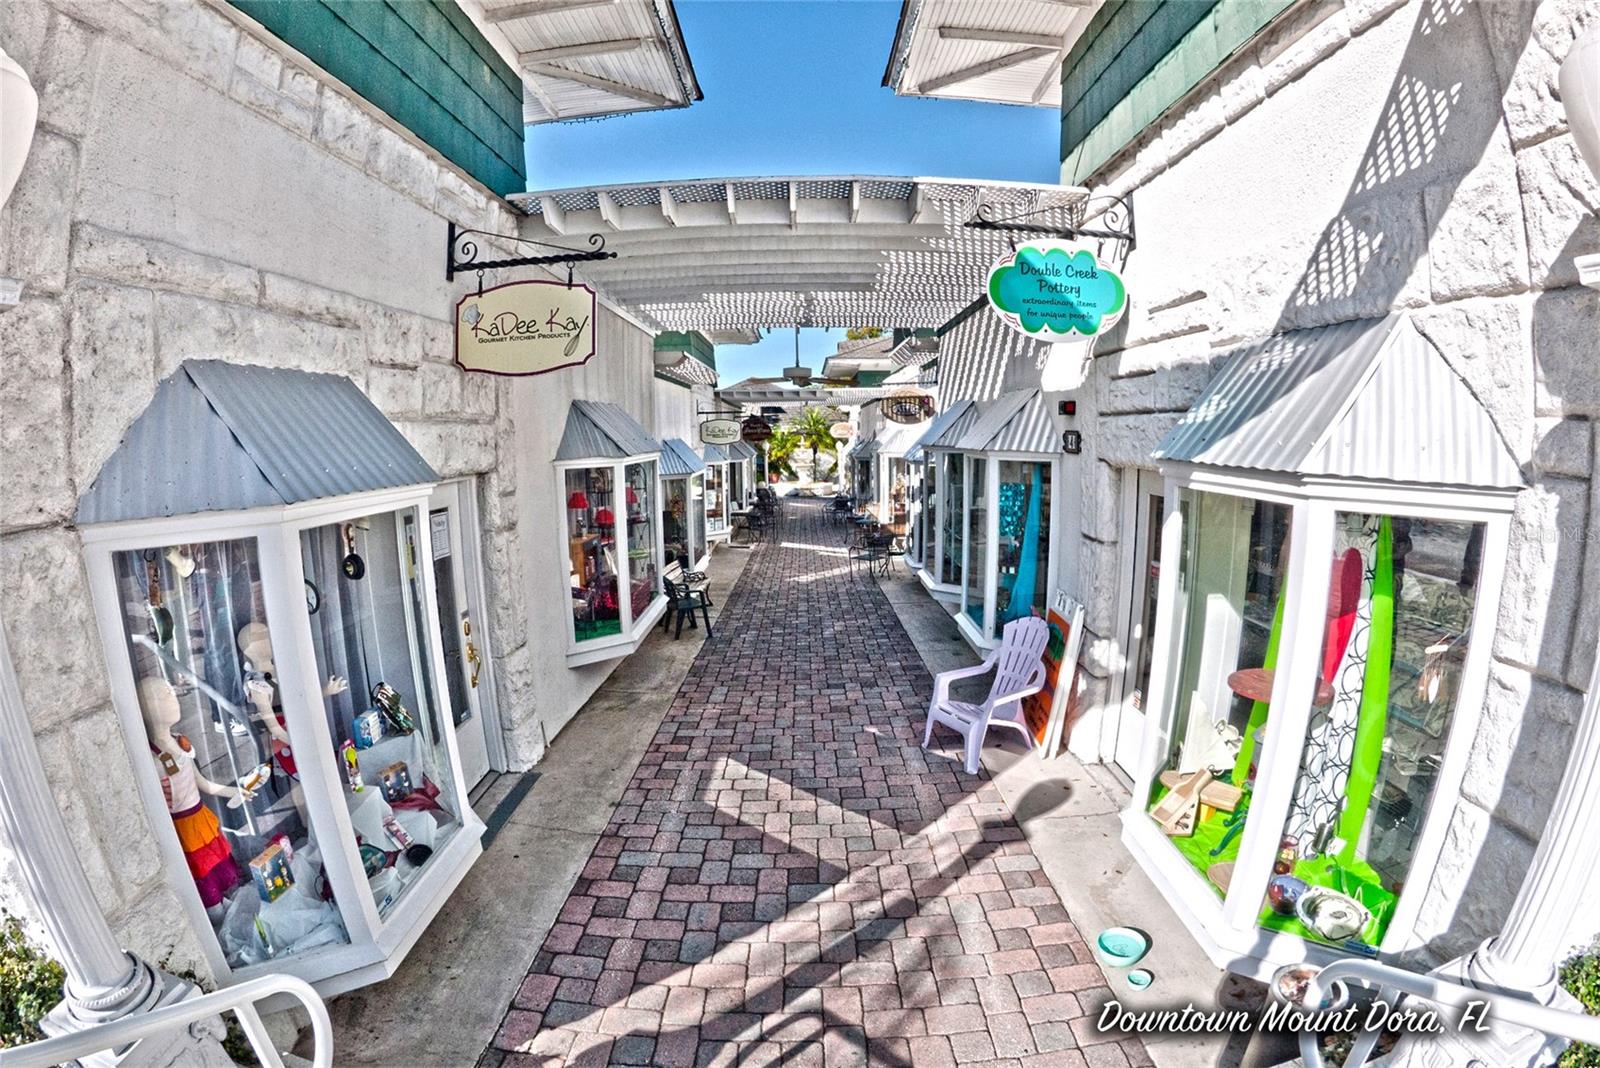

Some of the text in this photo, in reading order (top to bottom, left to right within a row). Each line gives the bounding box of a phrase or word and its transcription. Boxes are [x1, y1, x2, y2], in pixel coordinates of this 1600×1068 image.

[1019, 261, 1099, 280] Double Creek
[1036, 279, 1081, 298] Pottery
[1022, 298, 1097, 309] extraordinary items
[1026, 308, 1094, 321] for unique people
[471, 307, 589, 357] KaDee Kay
[537, 332, 571, 340] PRODUCTS
